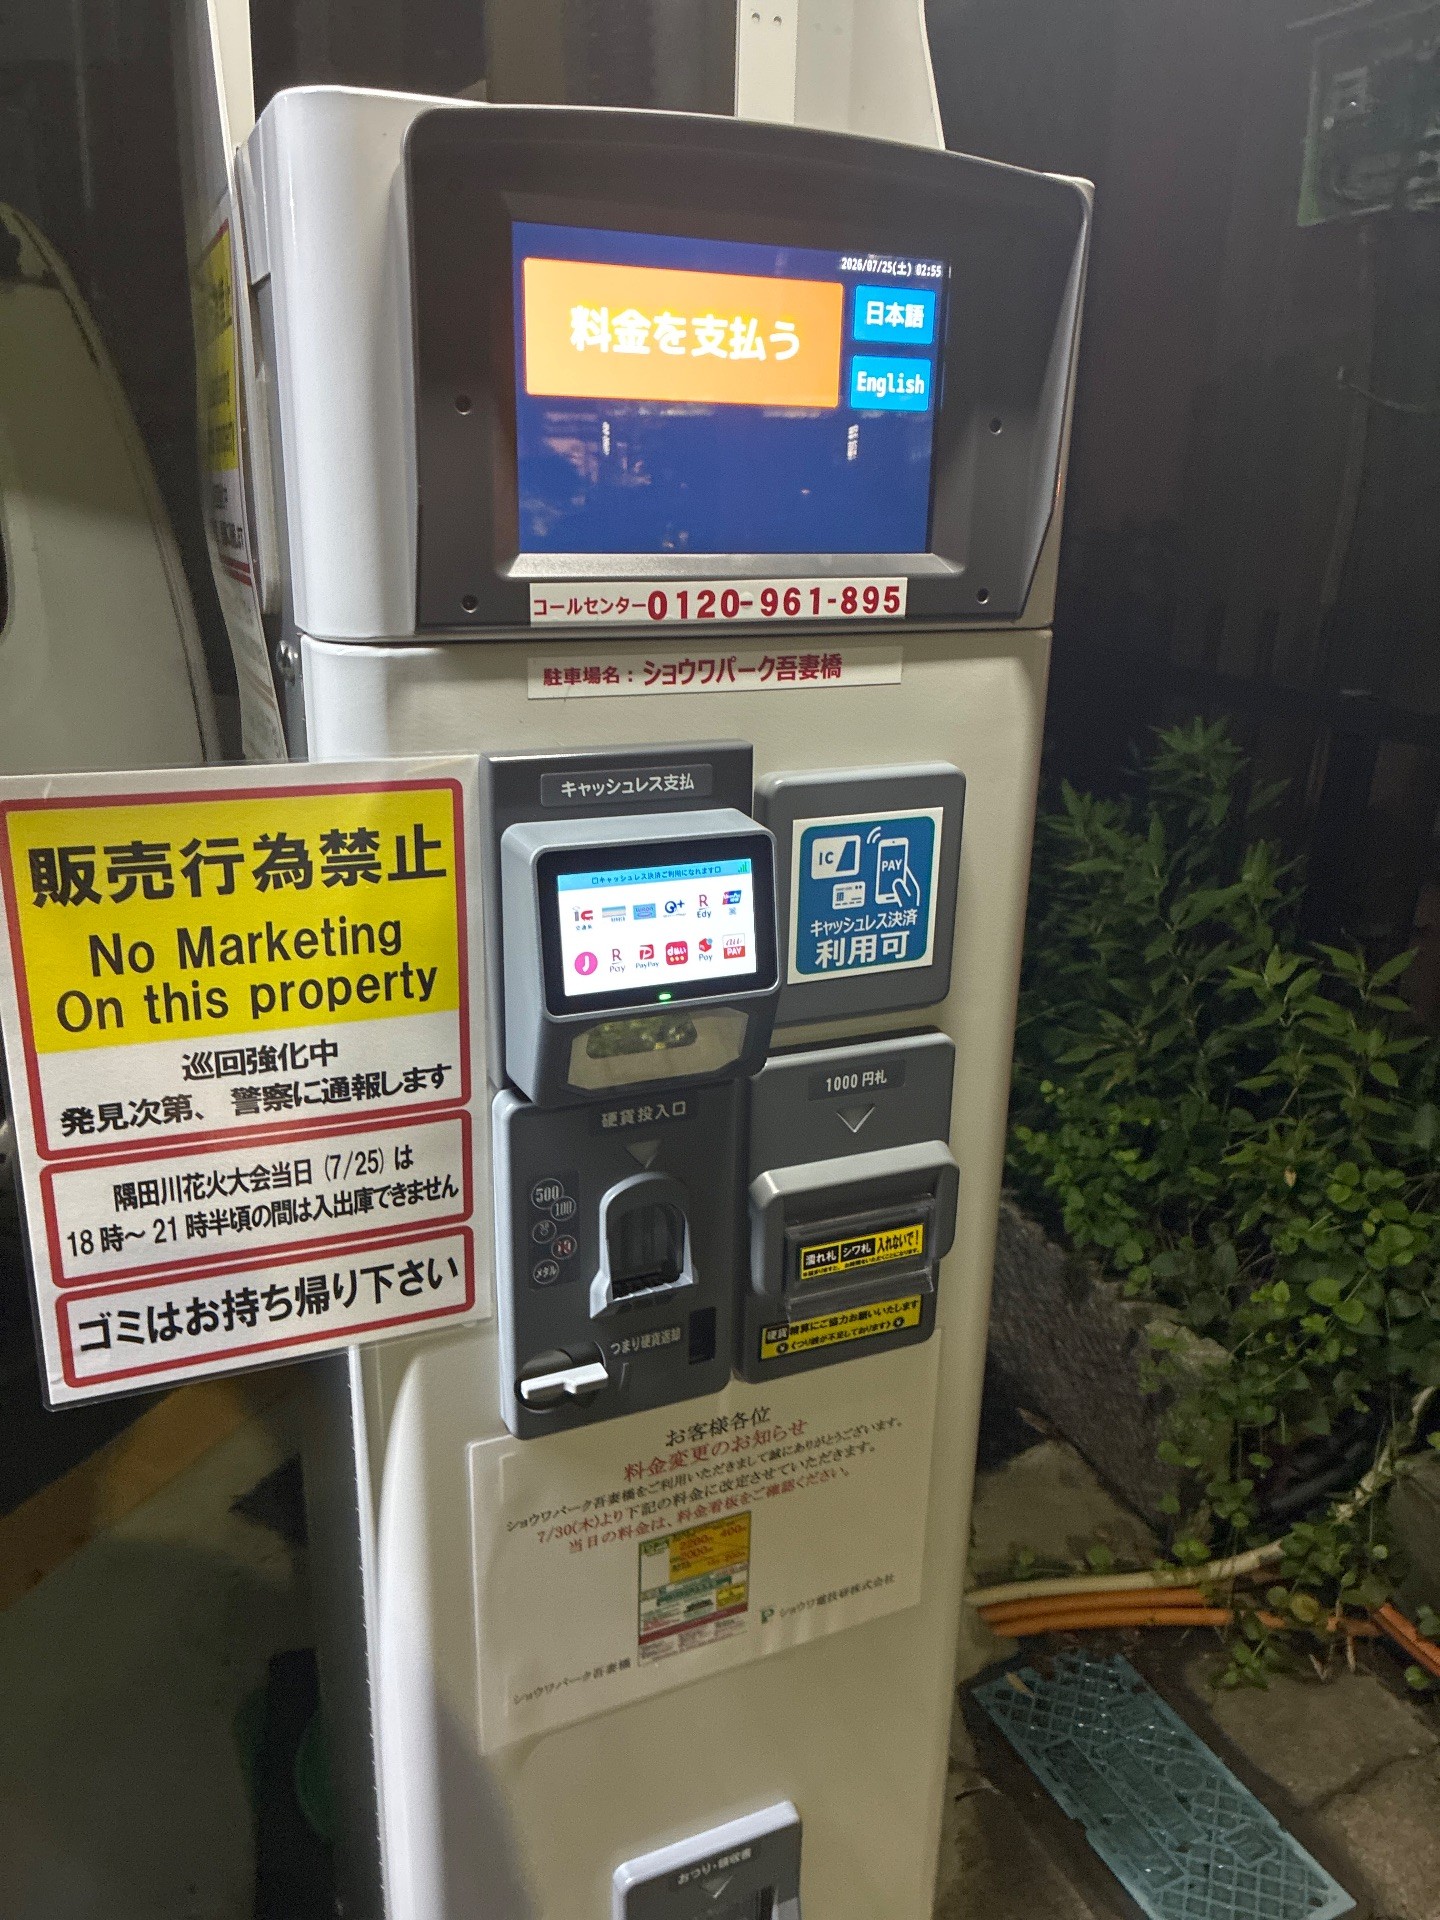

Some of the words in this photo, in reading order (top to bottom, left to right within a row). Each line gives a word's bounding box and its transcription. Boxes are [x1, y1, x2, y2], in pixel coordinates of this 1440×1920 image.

[840, 257, 912, 277] 2026/07/25(土)
[915, 264, 942, 278] 02:55
[866, 300, 925, 329] 日本語
[570, 305, 800, 362] 料金を支払う
[856, 370, 925, 398] English
[561, 772, 695, 799] キャッシュレス支払
[28, 823, 447, 909] 販売行為禁止
[818, 851, 834, 866] IC
[881, 859, 903, 872] PAY
[696, 910, 712, 919] Edy
[810, 908, 918, 938] キャッシュレス決済
[89, 932, 155, 977] No
[178, 916, 402, 971] Marketing
[726, 947, 742, 956] PAY
[815, 930, 910, 969] 利用可
[57, 988, 124, 1033] On
[146, 980, 229, 1025] this
[252, 962, 439, 1021] property
[182, 1038, 339, 1082] 巡回強化中
[535, 1185, 559, 1203] 500
[555, 1200, 573, 1217] 100
[842, 1242, 872, 1258] シワ札
[78, 1257, 459, 1352] ゴミはお持ち帰り下さい
[665, 1406, 771, 1447] お客様各位
[623, 1419, 807, 1482] 料金変更のお知らせ
